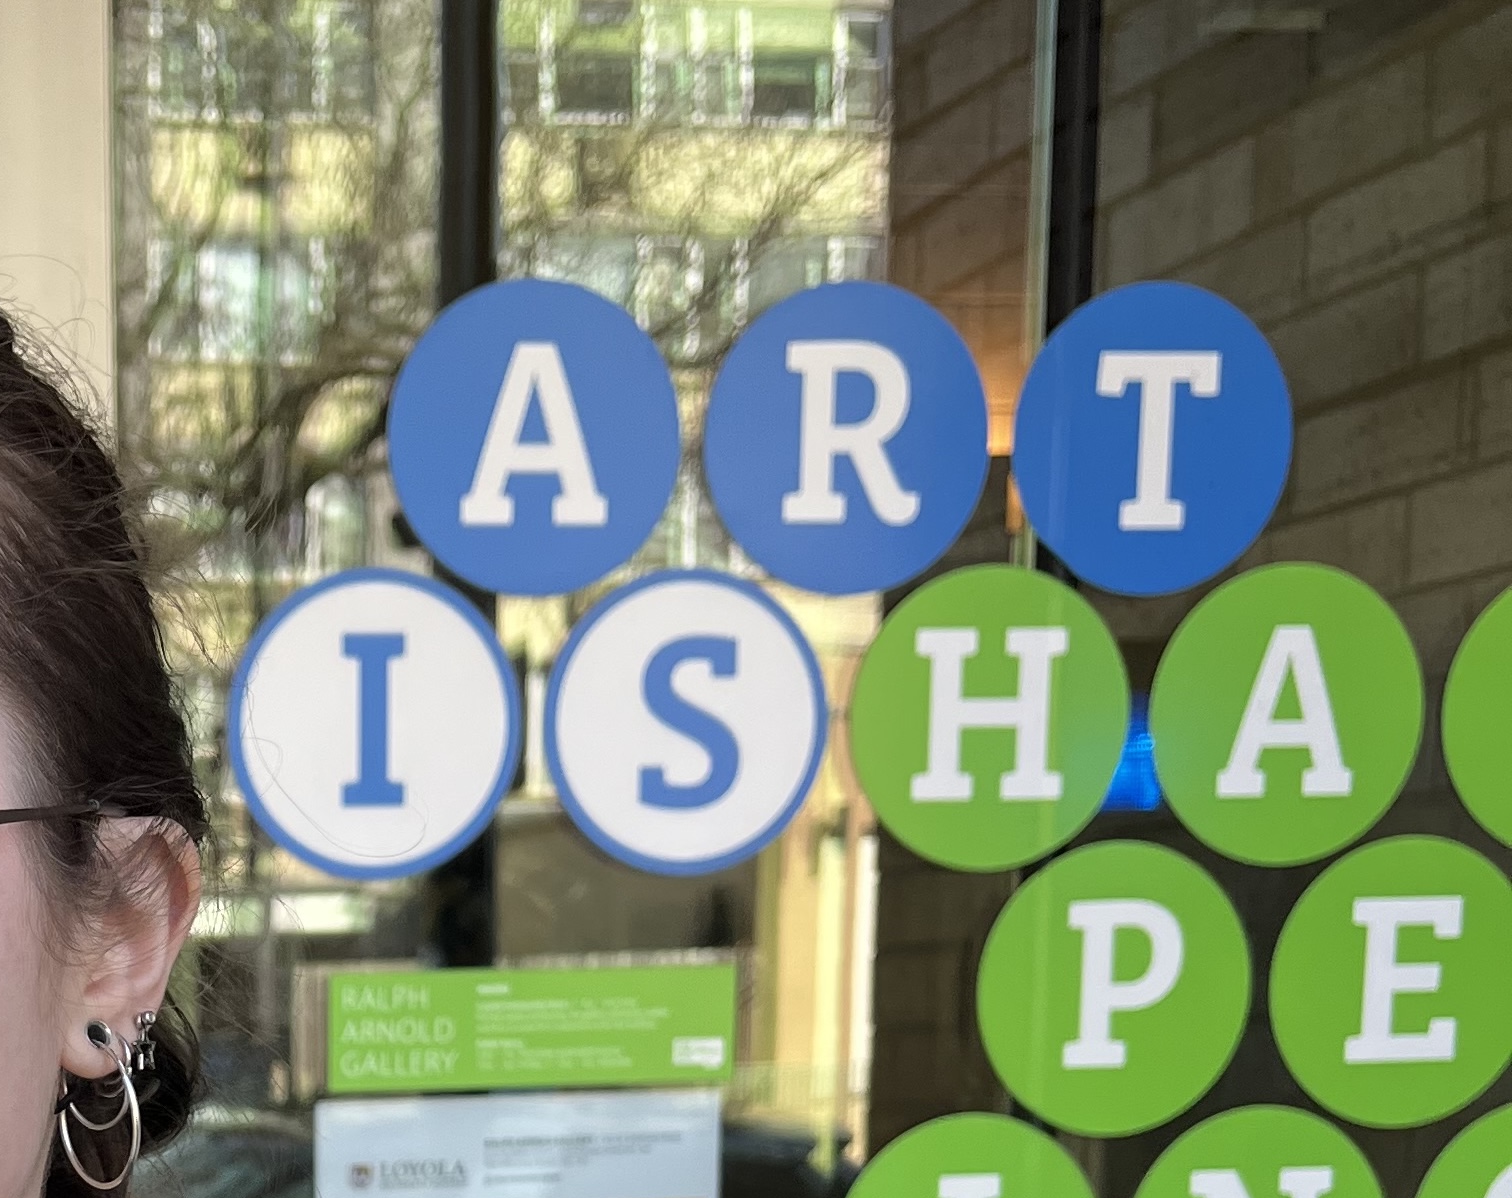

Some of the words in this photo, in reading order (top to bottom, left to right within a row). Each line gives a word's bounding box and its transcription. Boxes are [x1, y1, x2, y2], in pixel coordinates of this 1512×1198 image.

[458, 340, 1222, 530] ART
[1061, 896, 1464, 1070] PE
[340, 984, 430, 1013] RALPH
[340, 1016, 457, 1046] ARNOLD
[339, 1048, 459, 1079] GALLERY
[378, 1160, 466, 1179] LOYOLA
